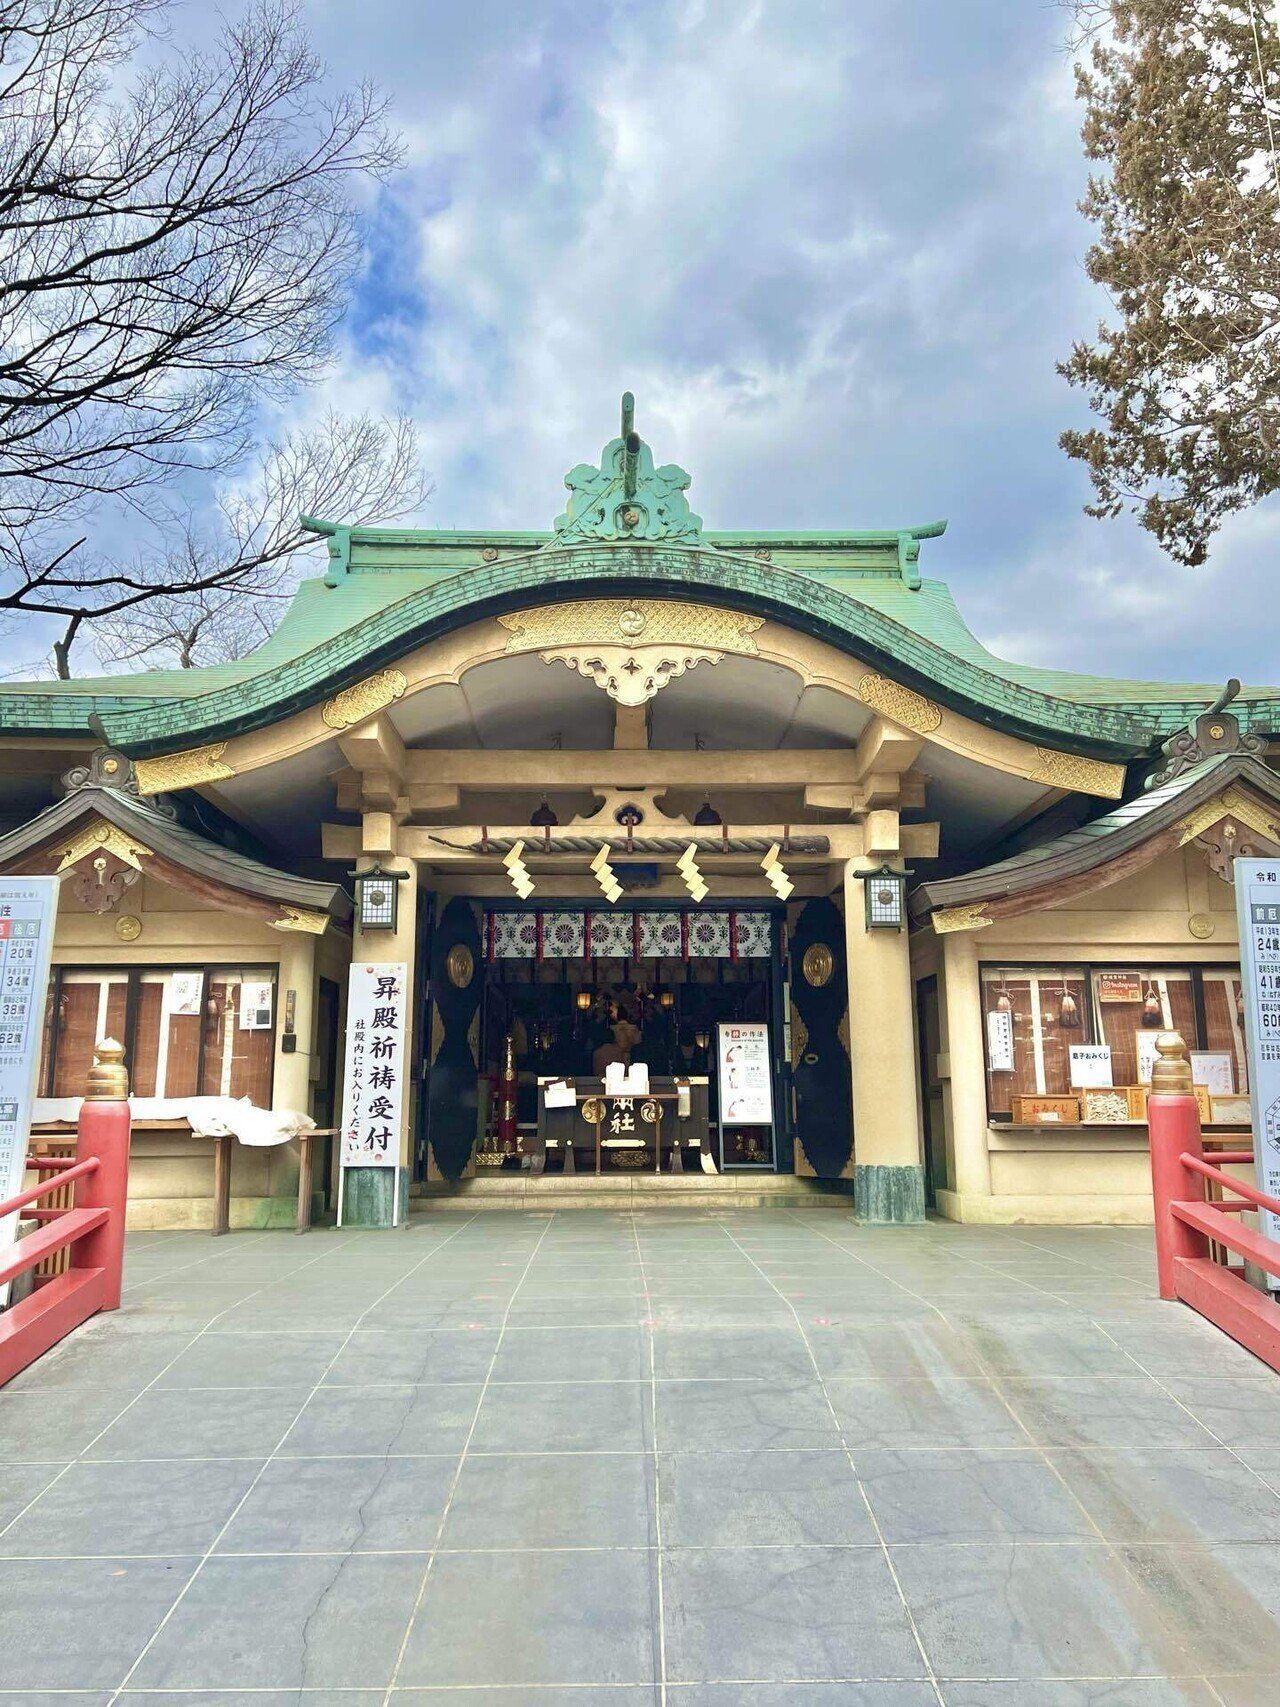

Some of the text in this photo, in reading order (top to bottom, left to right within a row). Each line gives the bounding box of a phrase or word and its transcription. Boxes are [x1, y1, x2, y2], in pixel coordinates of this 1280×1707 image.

[1256, 872, 1277, 882] 令和
[1258, 938, 1280, 950] 24歳
[1263, 1014, 1280, 1027] 60
[365, 976, 398, 1151] 昇殿祈祷受付
[348, 1019, 366, 1151] 社殿内にお入りください
[1032, 1103, 1068, 1113] おみくじ
